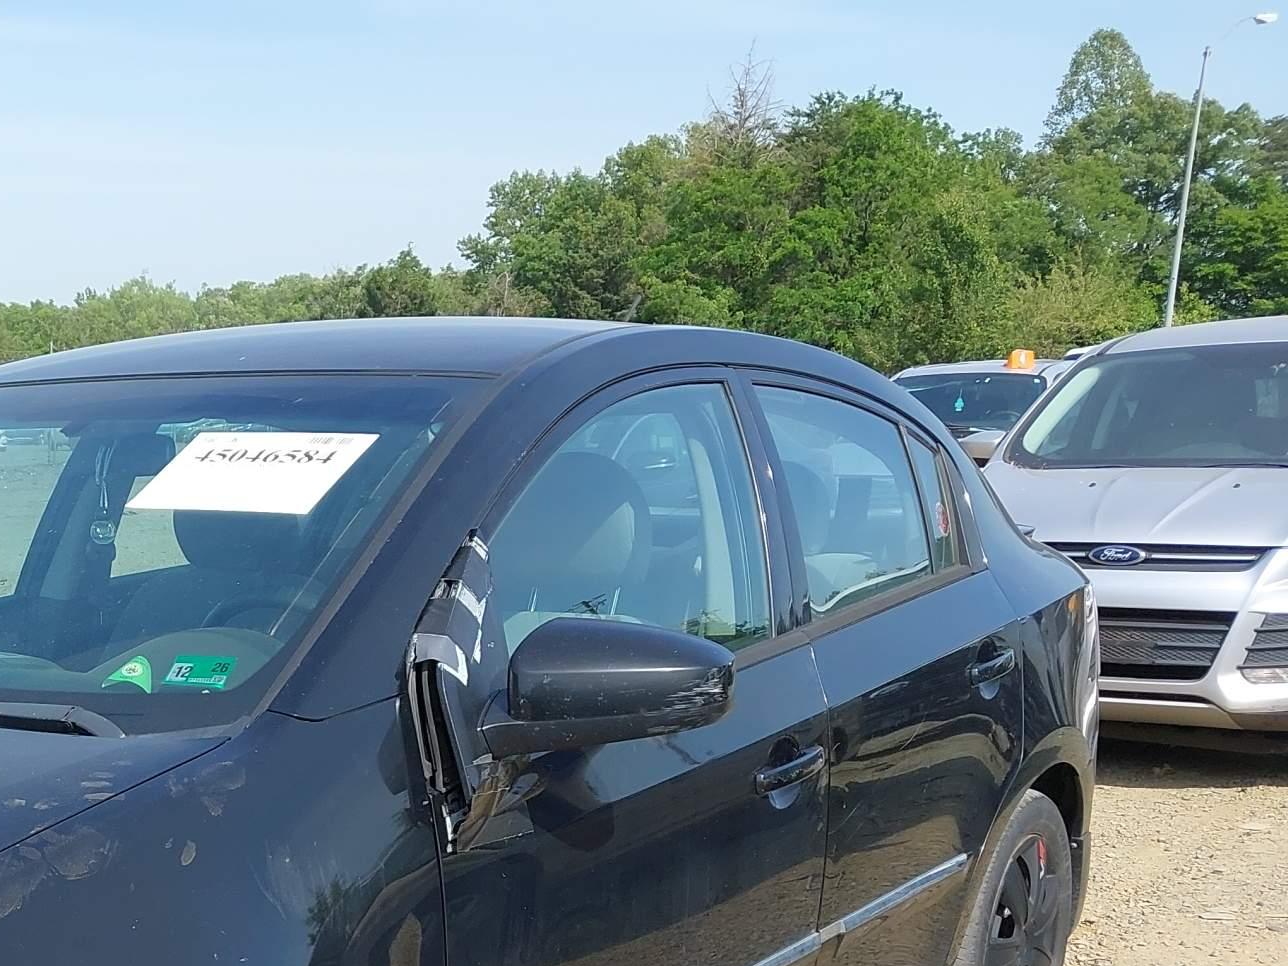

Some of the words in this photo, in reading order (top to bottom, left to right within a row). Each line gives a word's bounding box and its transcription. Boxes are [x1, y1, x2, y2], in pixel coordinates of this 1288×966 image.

[195, 449, 337, 464] 45046584
[1100, 548, 1132, 560] Ford
[175, 666, 193, 679] 12
[212, 662, 230, 673] 26
